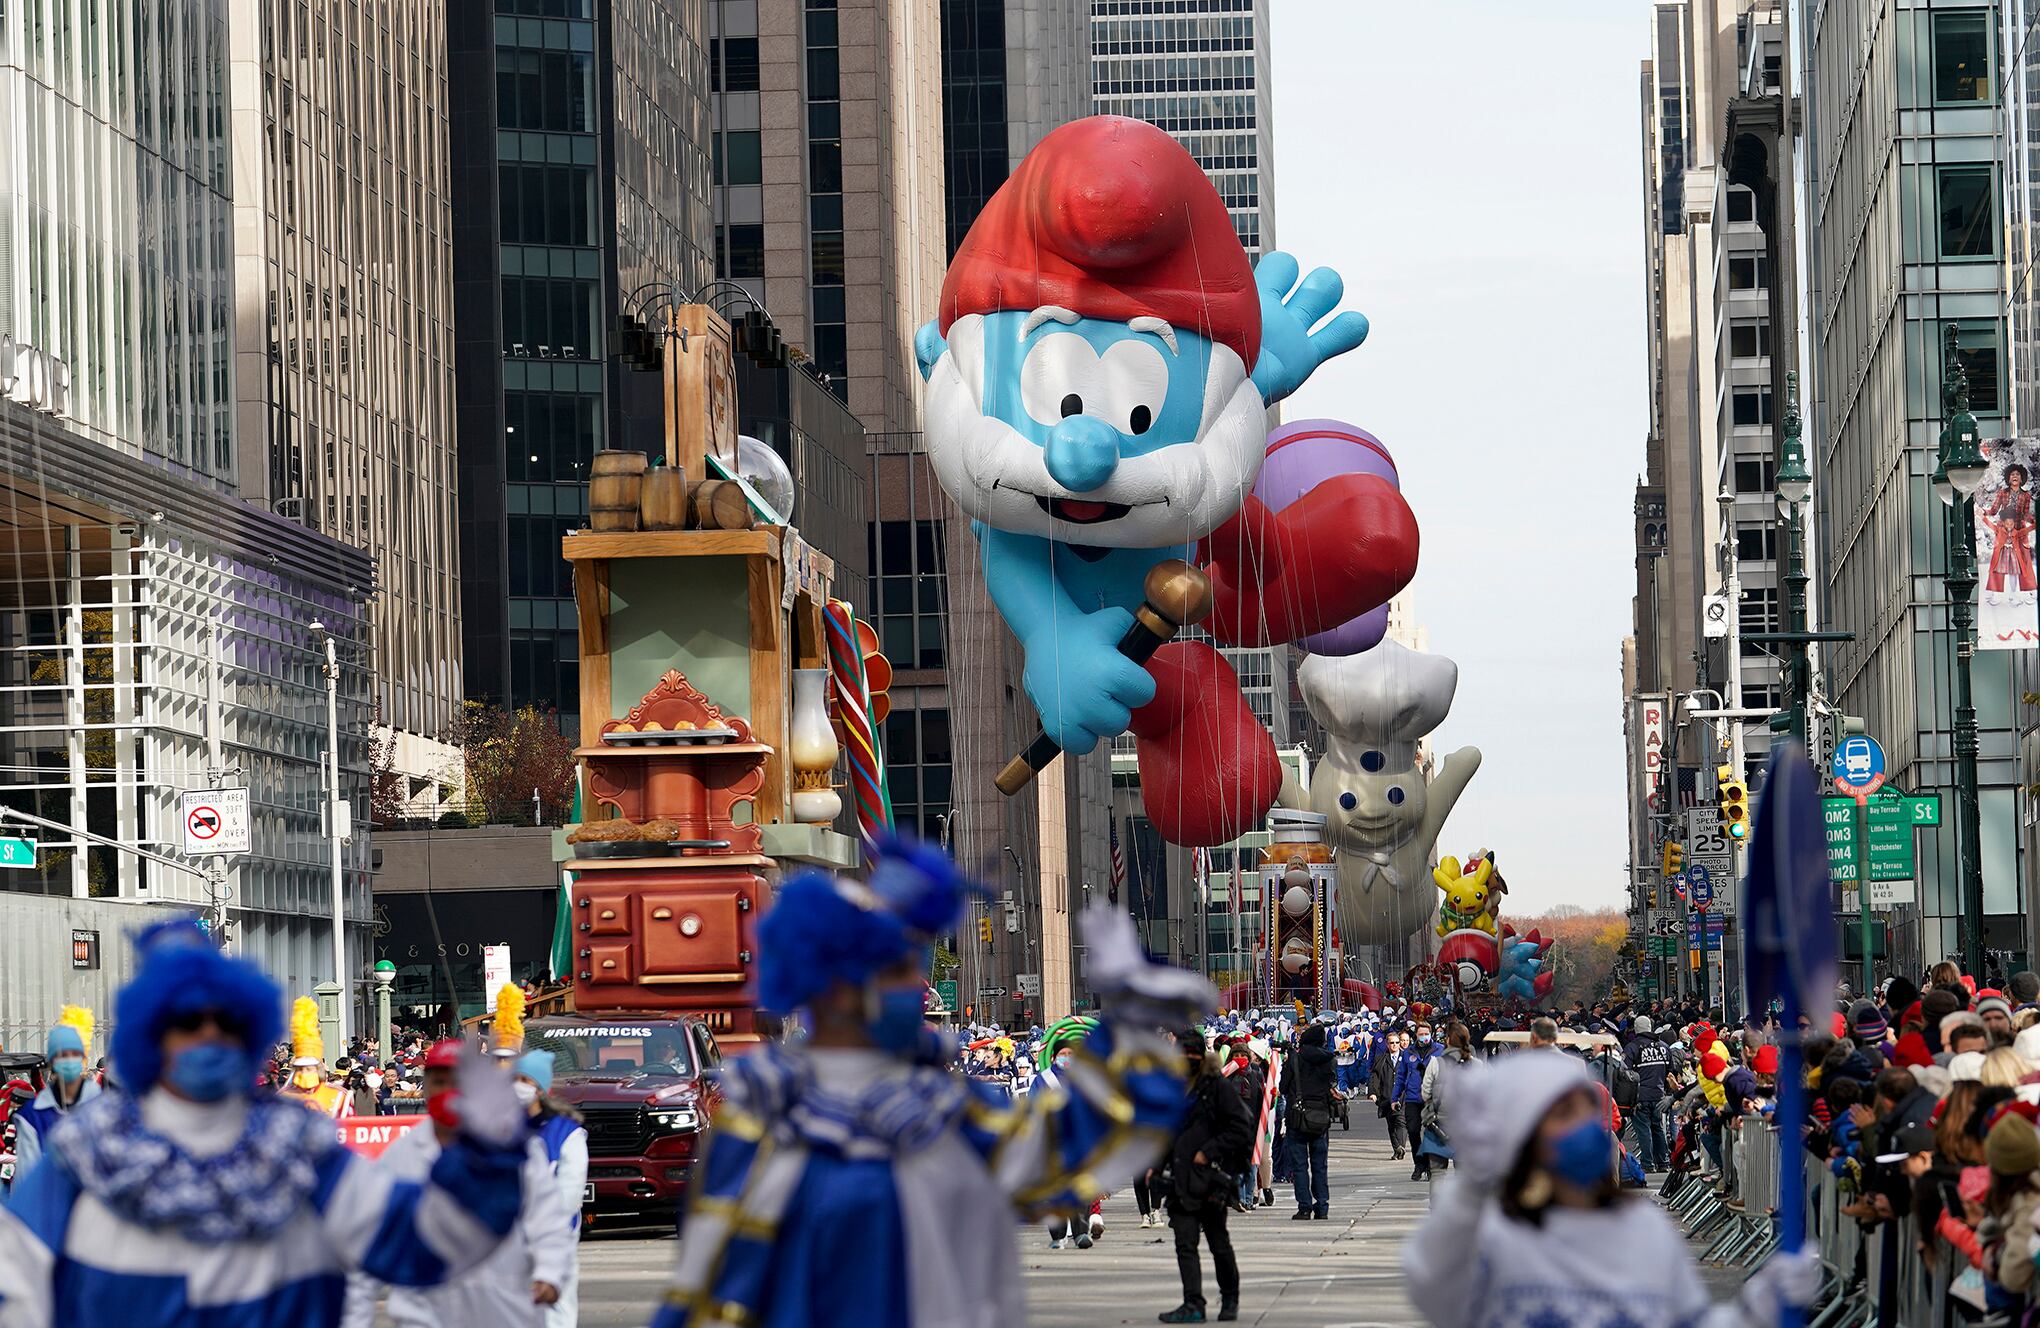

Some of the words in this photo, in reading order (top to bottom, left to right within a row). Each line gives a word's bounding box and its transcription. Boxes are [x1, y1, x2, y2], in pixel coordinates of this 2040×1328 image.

[186, 794, 223, 804] RESTRICTED
[227, 793, 245, 802] AREA
[1825, 808, 1851, 824] QM2
[1870, 807, 1879, 815] Bay
[1914, 803, 1933, 820] St
[224, 829, 246, 838] OVER
[1826, 827, 1852, 842] QM3
[1694, 834, 1726, 853] 25
[3, 844, 14, 860] St
[1827, 845, 1852, 861] QM4
[1828, 864, 1856, 879] QM20
[1709, 878, 1727, 888] SES
[408, 944, 419, 958] &
[543, 1027, 653, 1039] #RAMTRUCKS
[1641, 1046, 1667, 1057] NYPD
[355, 1126, 393, 1144] DAY
